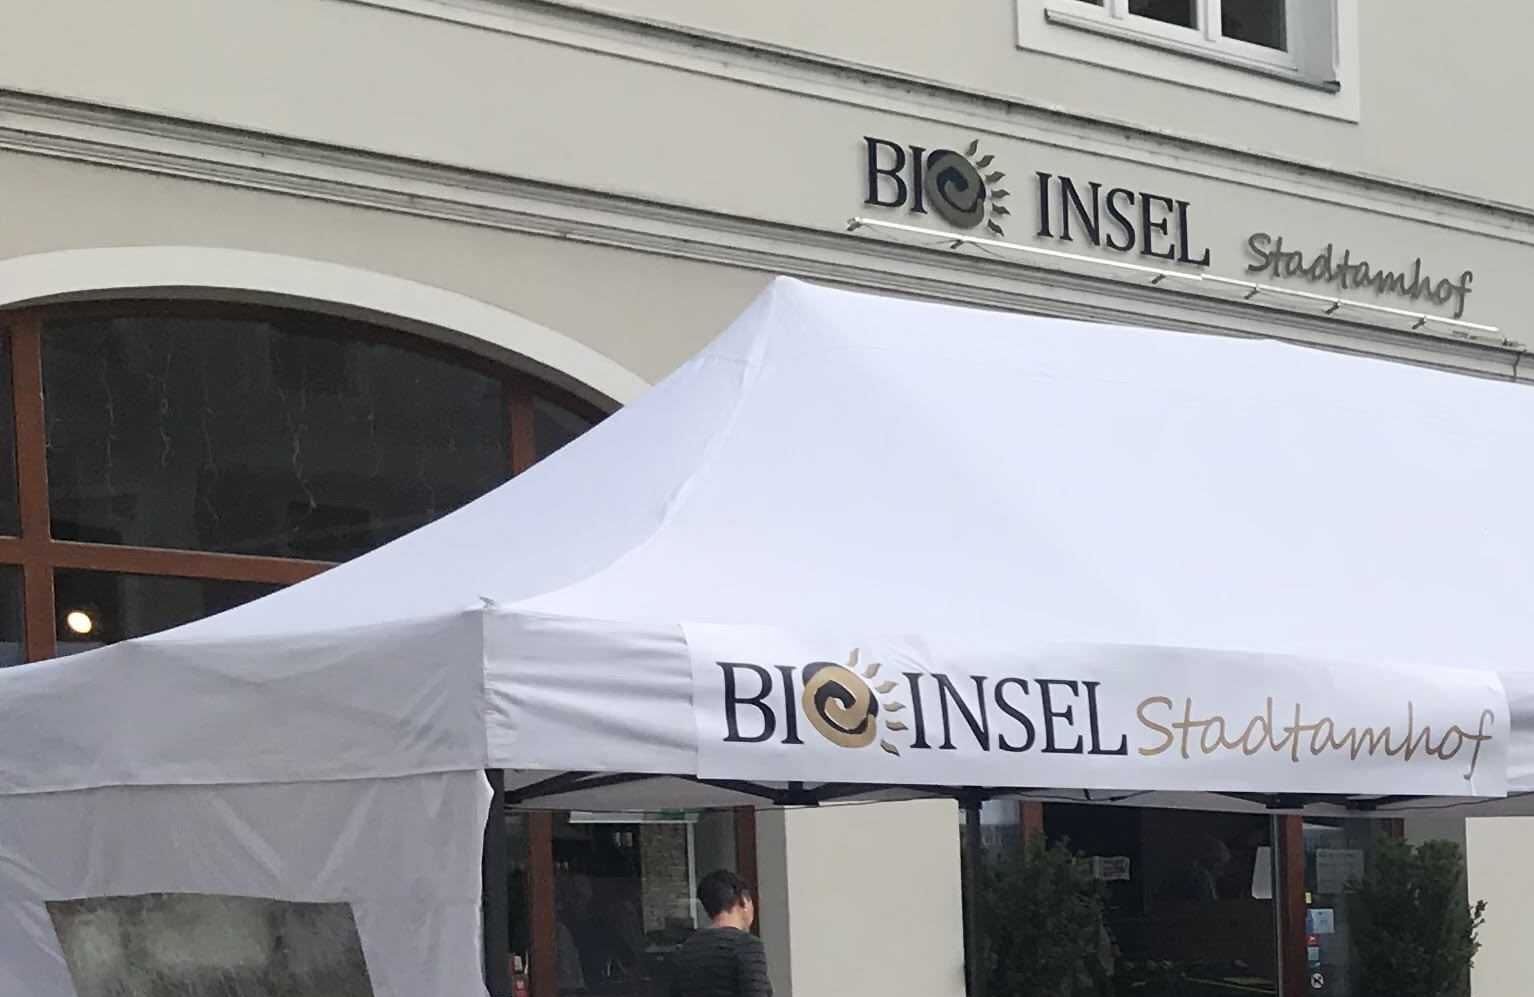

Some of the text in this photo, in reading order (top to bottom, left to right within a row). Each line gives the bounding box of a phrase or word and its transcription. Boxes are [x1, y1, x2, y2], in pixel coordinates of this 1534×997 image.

[1036, 171, 1211, 267] INSEL
[1245, 231, 1474, 319] Stadtamhof
[909, 673, 1129, 757] INSEL
[1136, 695, 1494, 781] Stadtamhof
